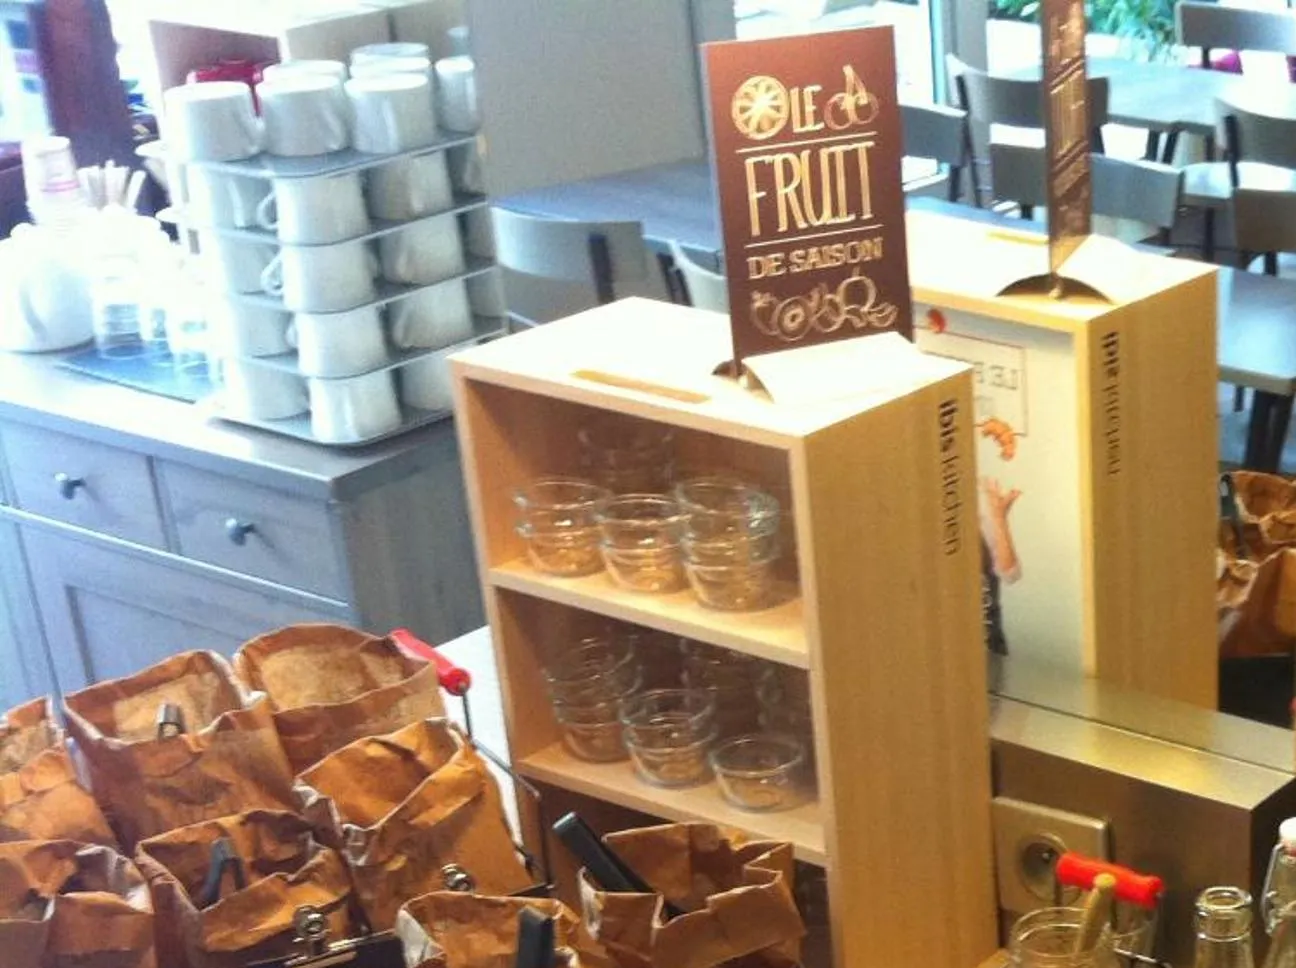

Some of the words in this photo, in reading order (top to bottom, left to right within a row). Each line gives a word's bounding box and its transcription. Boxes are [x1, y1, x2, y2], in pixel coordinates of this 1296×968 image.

[790, 85, 825, 133] LE
[745, 141, 875, 236] FRUIT
[747, 253, 785, 279] DE
[789, 237, 883, 272] SAISON
[938, 399, 958, 452] ibis
[941, 455, 962, 556] kitchen
